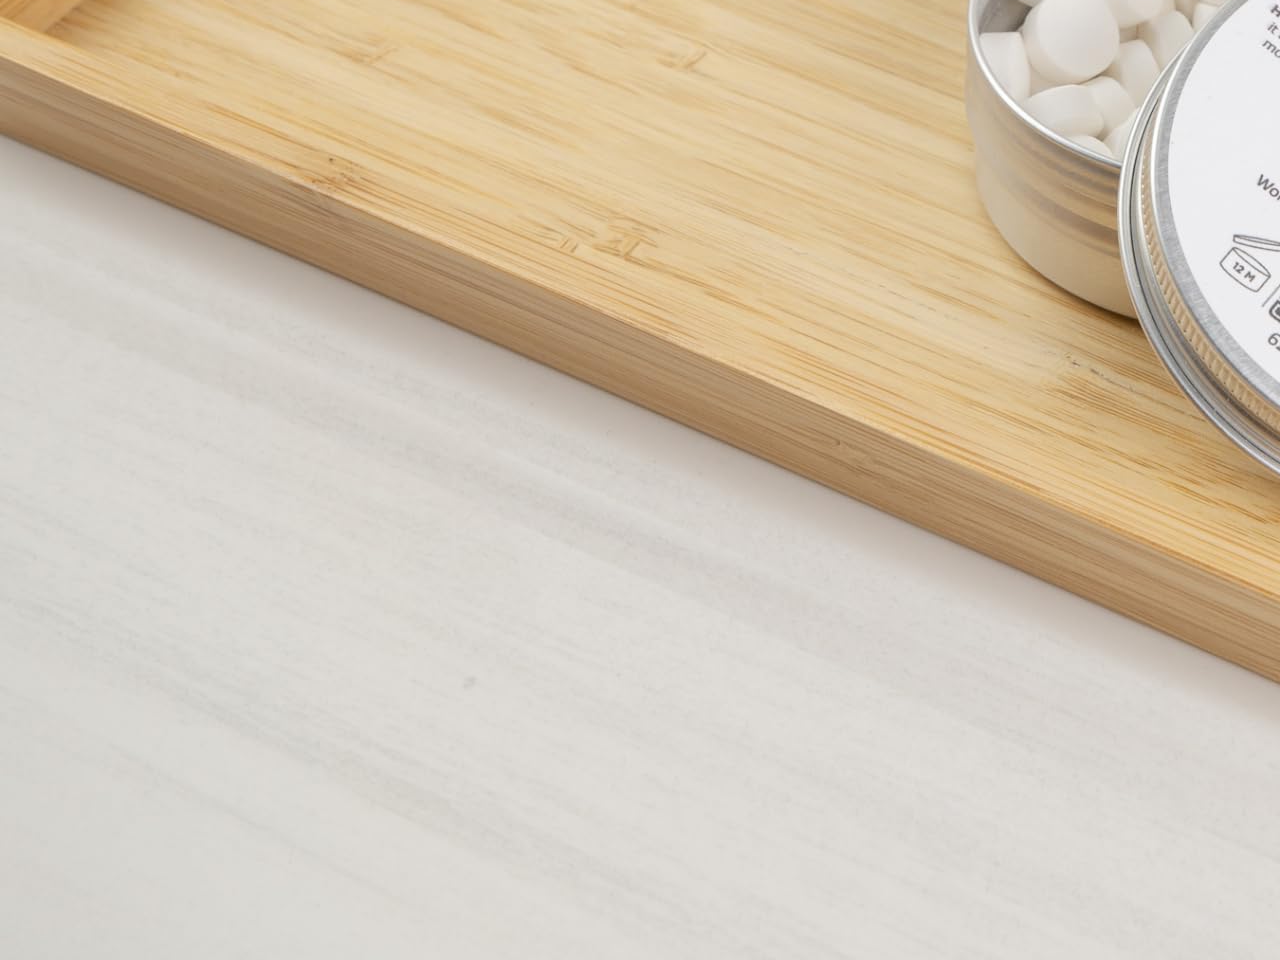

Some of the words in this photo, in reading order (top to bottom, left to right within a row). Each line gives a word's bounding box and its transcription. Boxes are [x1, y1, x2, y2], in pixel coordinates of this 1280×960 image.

[1266, 21, 1279, 34] it
[1232, 261, 1245, 274] 12
[1243, 270, 1256, 282] M
